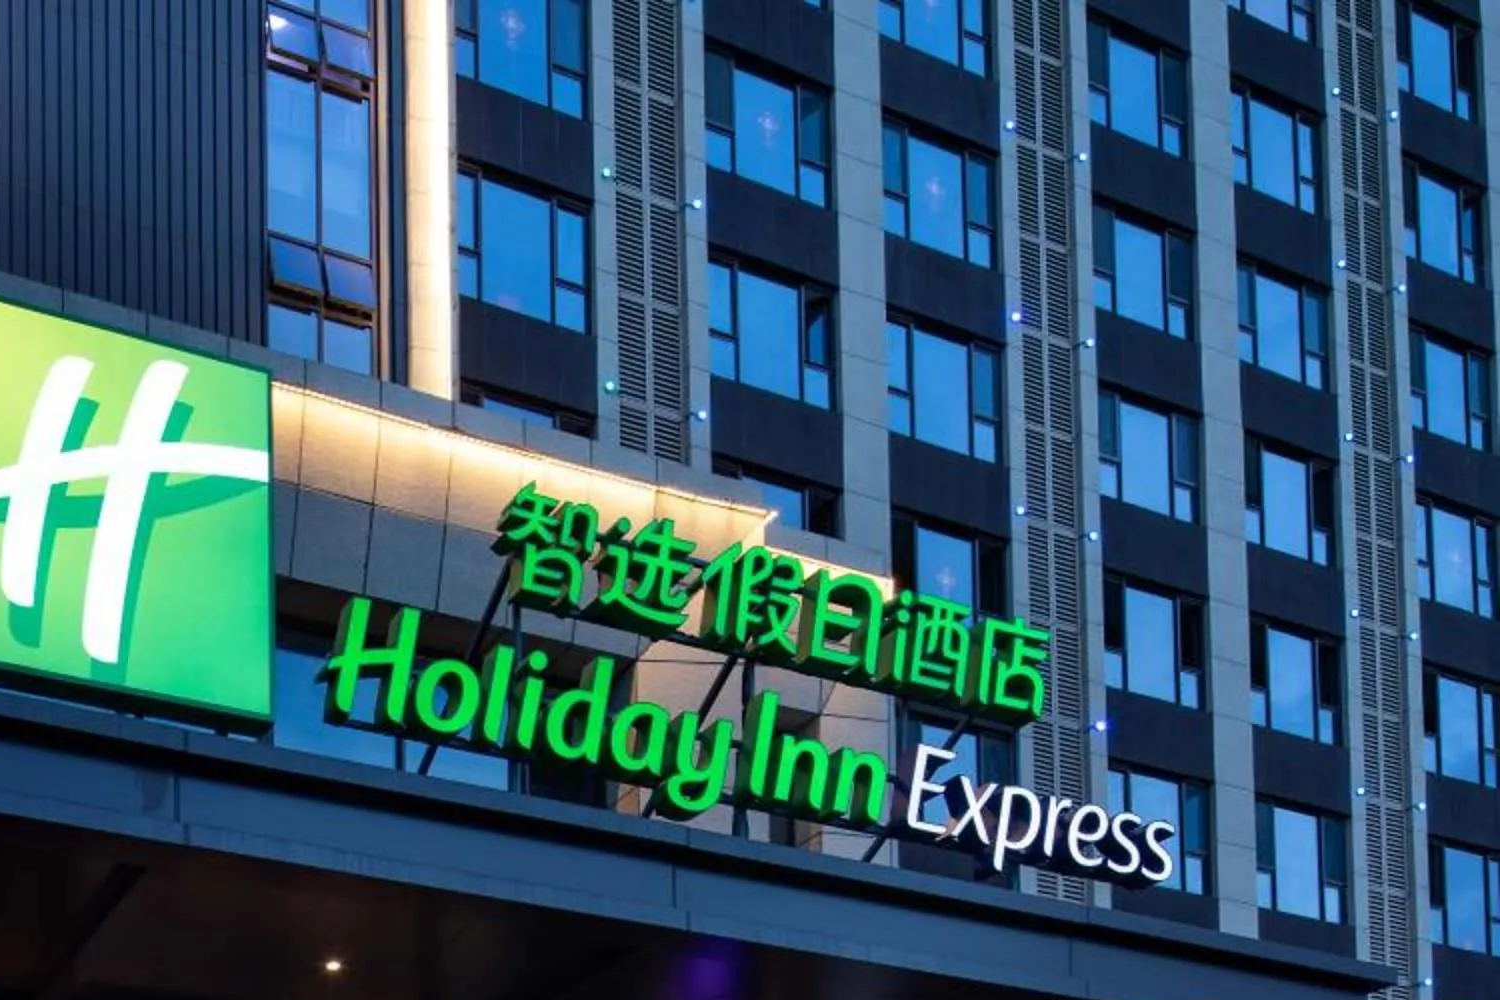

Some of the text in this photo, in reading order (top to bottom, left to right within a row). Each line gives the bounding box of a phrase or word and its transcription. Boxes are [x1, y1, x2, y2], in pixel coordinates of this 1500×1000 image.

[506, 481, 1050, 717] 智选假日酒店
[327, 596, 1175, 882] Holiday Inn Express
